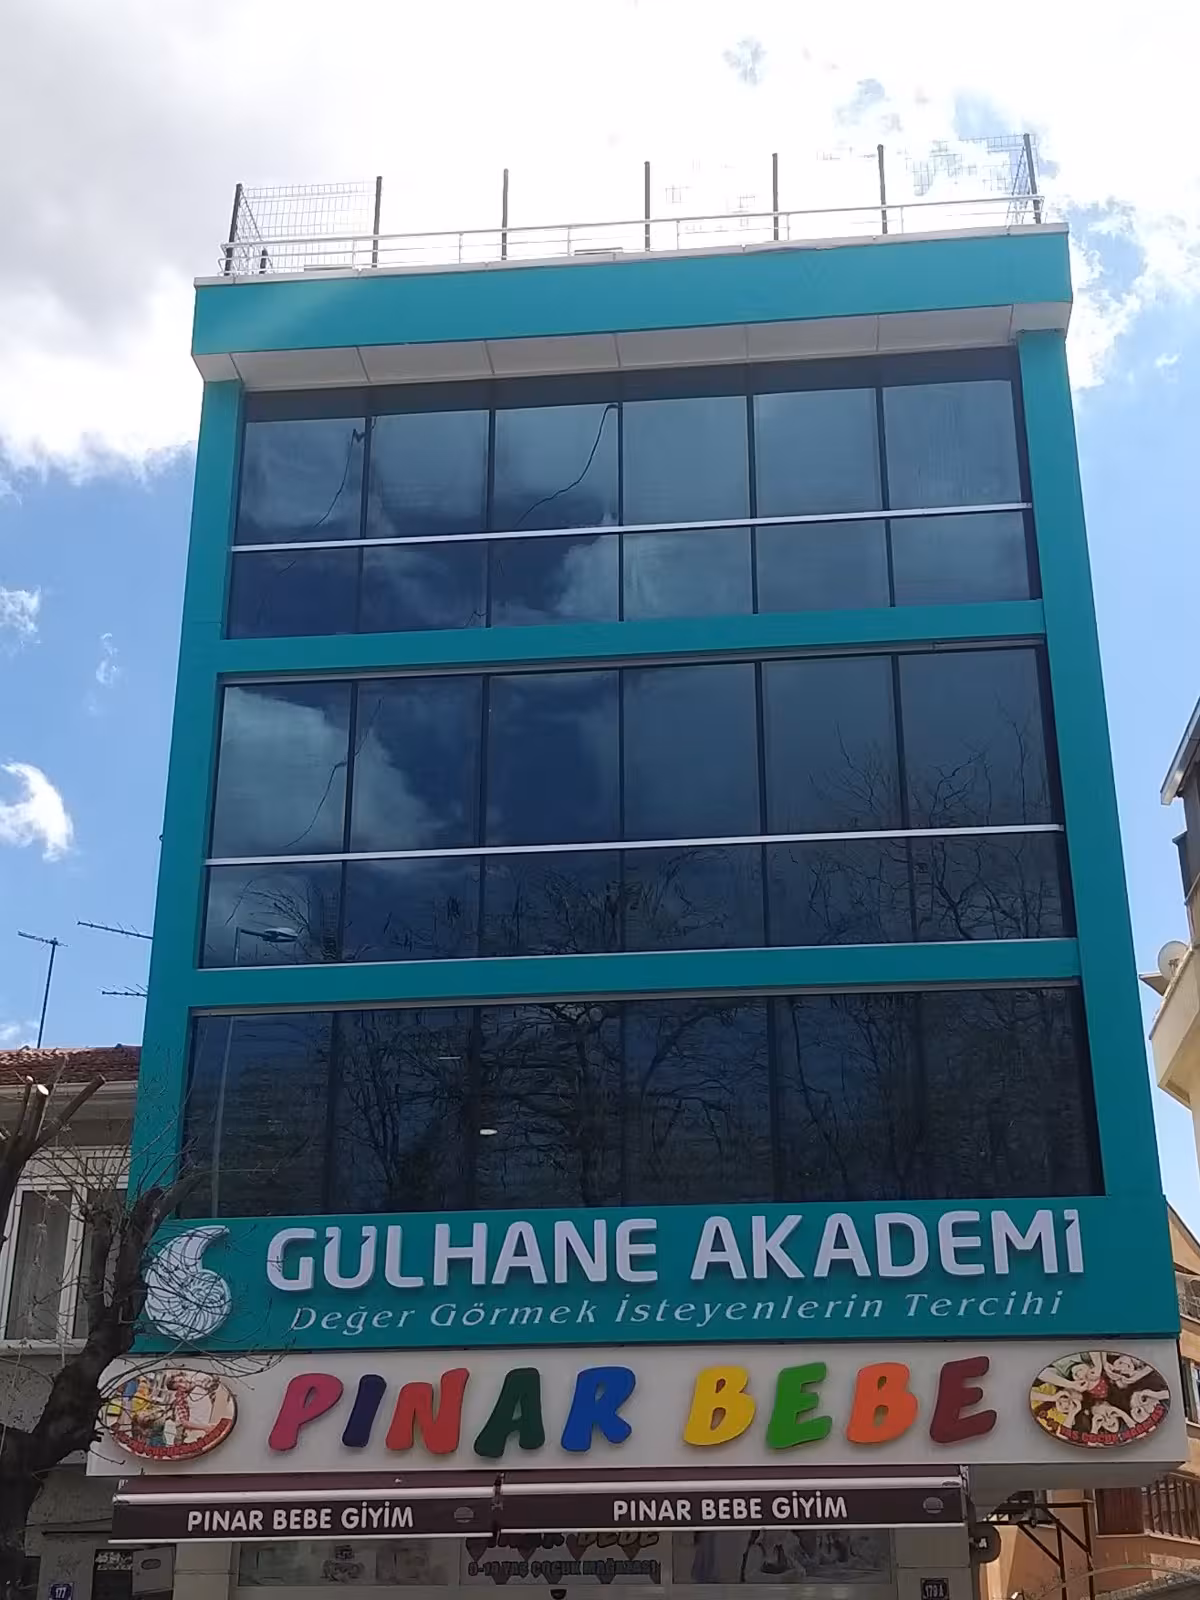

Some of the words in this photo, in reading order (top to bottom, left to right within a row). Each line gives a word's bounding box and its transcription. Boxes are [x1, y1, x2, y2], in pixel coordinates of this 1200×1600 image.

[290, 1305, 416, 1336] Değer
[429, 1297, 597, 1326] Görmek
[614, 1292, 884, 1328] İsteyenlerin
[904, 1289, 1064, 1318] Tercihi
[268, 1366, 636, 1458] PINAR
[683, 1356, 997, 1451] BEBE
[186, 1507, 263, 1532] PINAR
[271, 1504, 332, 1530] BEBE
[340, 1500, 414, 1529] GİYİM
[612, 1496, 692, 1522] PINAR
[700, 1494, 763, 1520] BEBE
[771, 1490, 848, 1520] GİYİM
